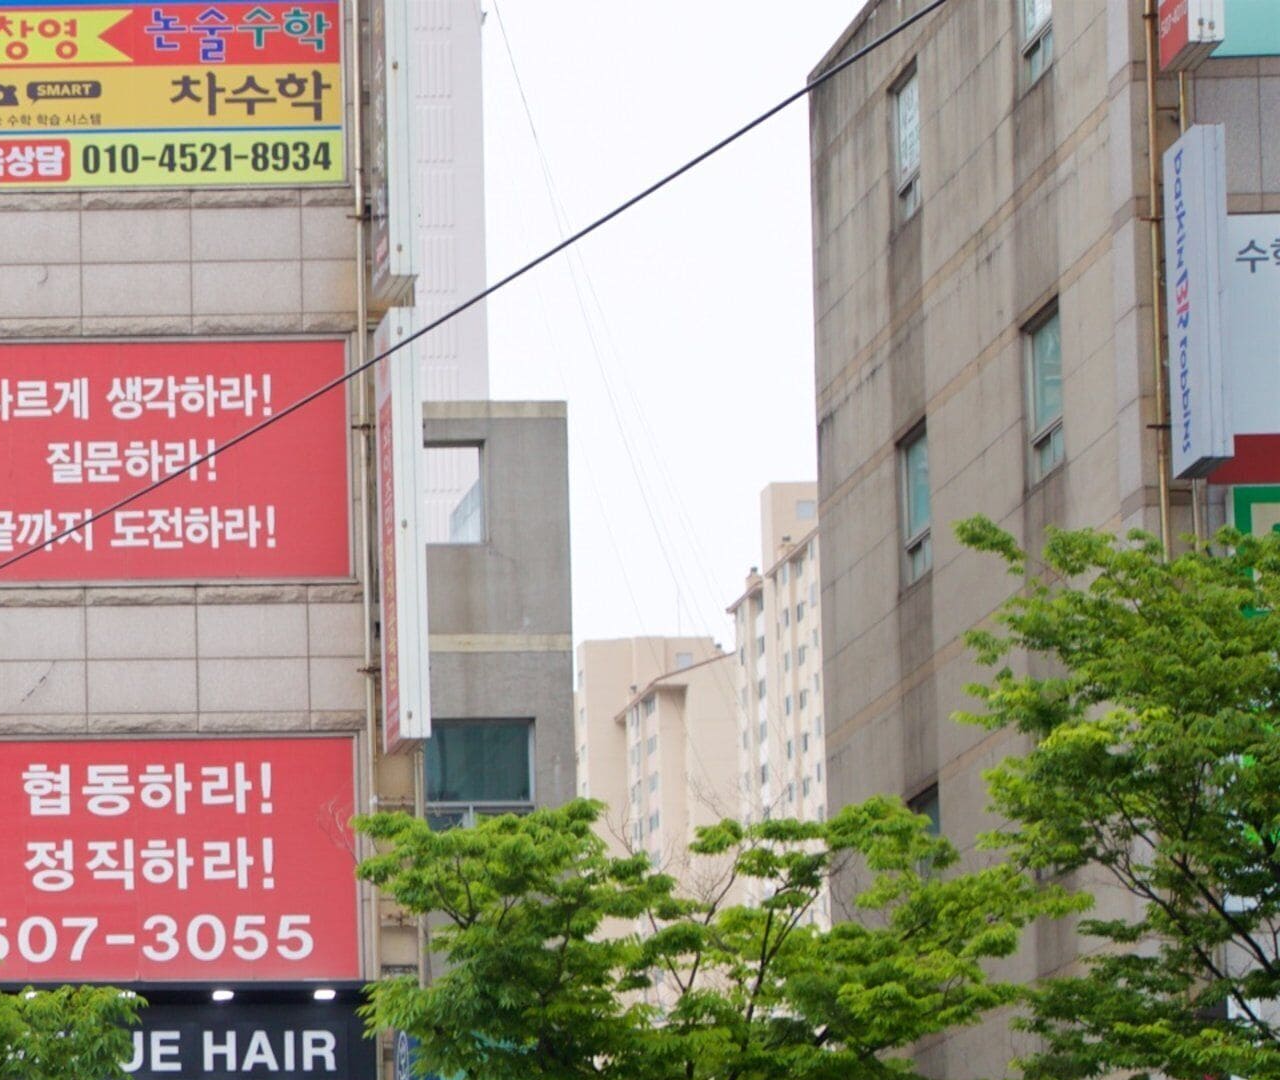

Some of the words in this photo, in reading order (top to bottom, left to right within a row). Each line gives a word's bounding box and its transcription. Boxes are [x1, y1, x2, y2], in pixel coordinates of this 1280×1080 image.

[145, 6, 332, 62] 논술수학
[37, 82, 93, 98] SMART
[170, 70, 332, 121] 차수학
[7, 114, 33, 127] 수학
[37, 113, 61, 127] 학습
[65, 112, 102, 127] 시스템
[81, 141, 332, 175] 010-4521-8934
[106, 373, 273, 420] 생각하라!
[45, 438, 218, 484] 질문하라!
[110, 505, 278, 549] 도전하라!
[22, 762, 274, 816] 협동하라!
[24, 837, 276, 892] 정직하라!
[202, 1029, 337, 1072] HAIR
